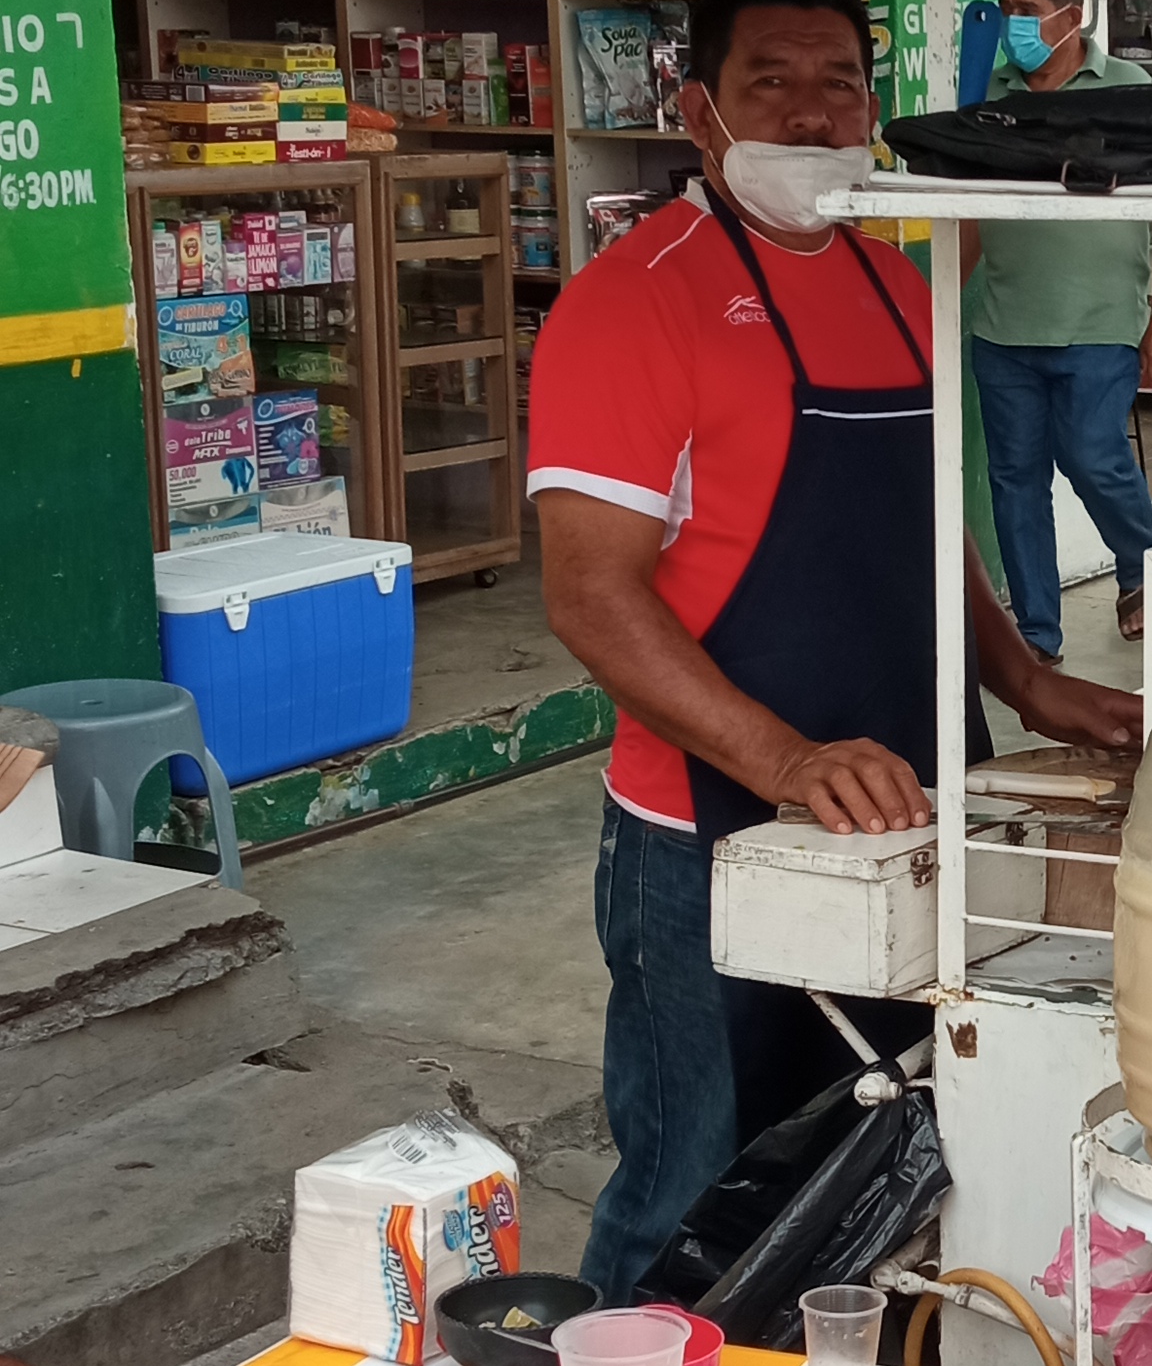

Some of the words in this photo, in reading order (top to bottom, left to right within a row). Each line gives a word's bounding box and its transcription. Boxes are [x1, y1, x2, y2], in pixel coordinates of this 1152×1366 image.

[601, 26, 637, 53] Soya
[492, 1192, 512, 1223] 125
[468, 1205, 502, 1279] nder
[386, 1245, 421, 1326] Tender
